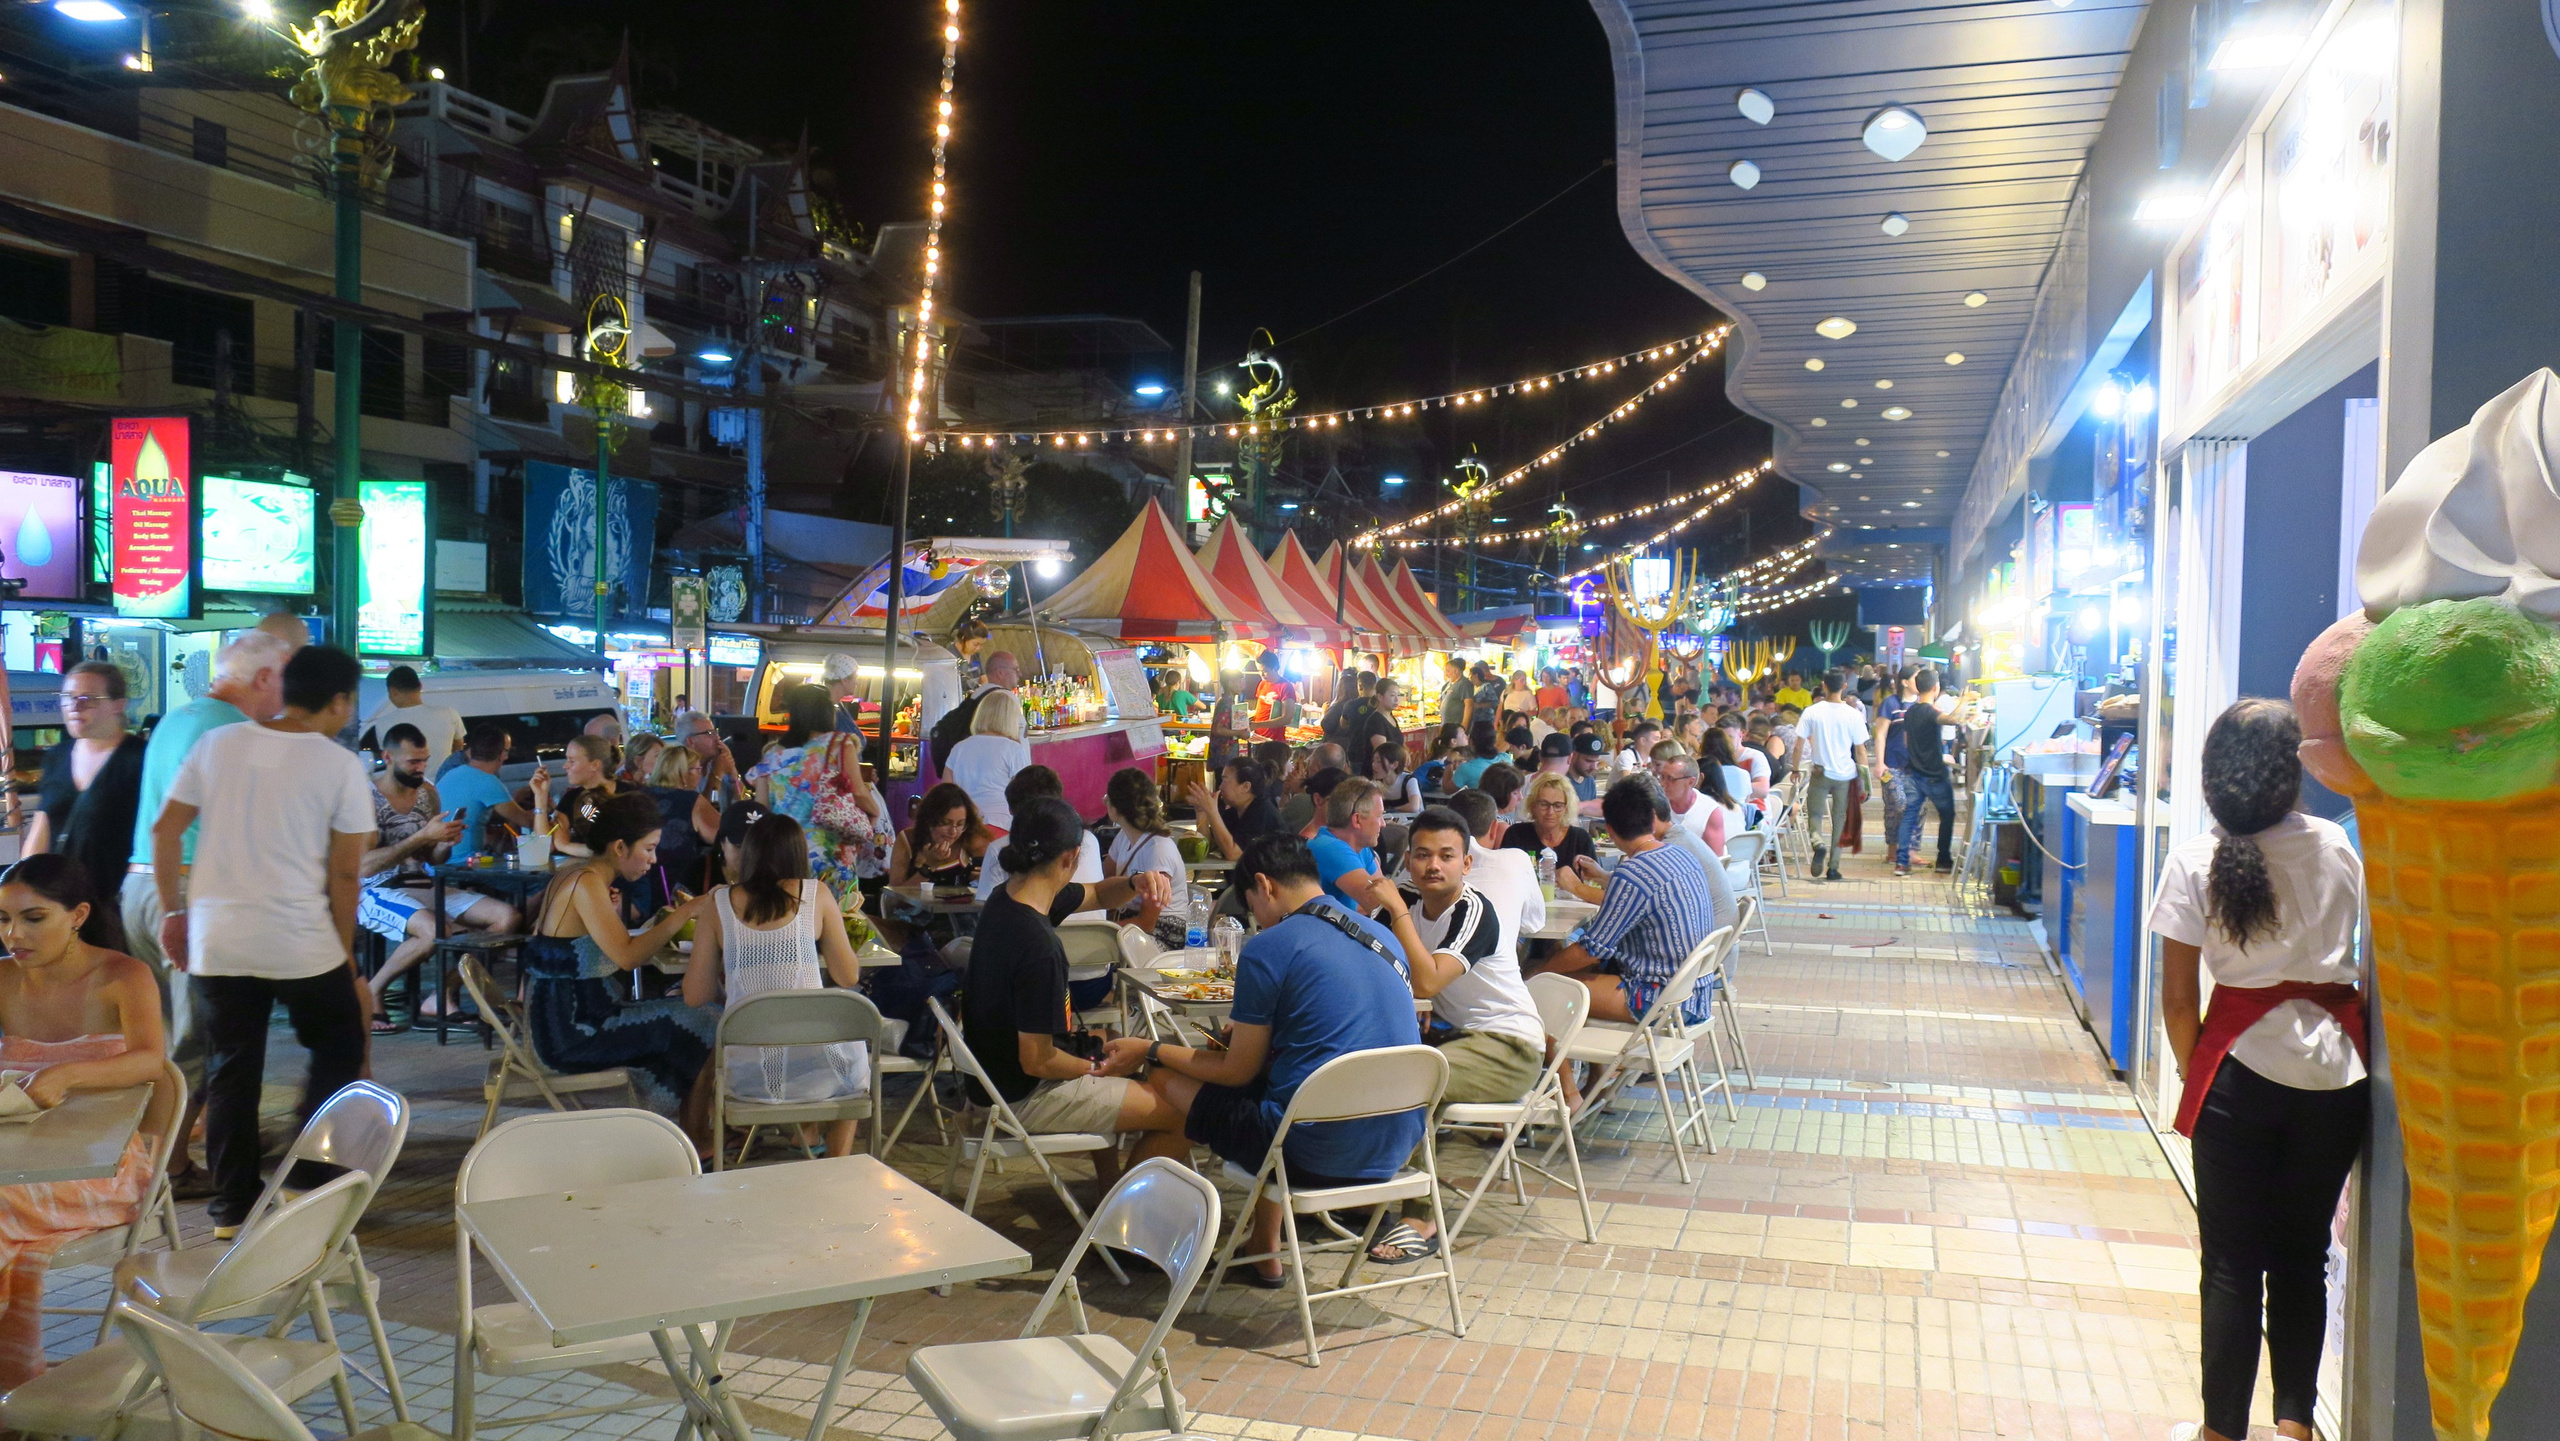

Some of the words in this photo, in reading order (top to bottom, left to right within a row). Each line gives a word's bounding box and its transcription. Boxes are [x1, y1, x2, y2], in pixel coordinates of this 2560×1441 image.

[13, 476, 37, 485] อะควา
[119, 477, 185, 501] AQUA
[143, 521, 169, 529] Massage
[139, 578, 162, 586] Waxing
